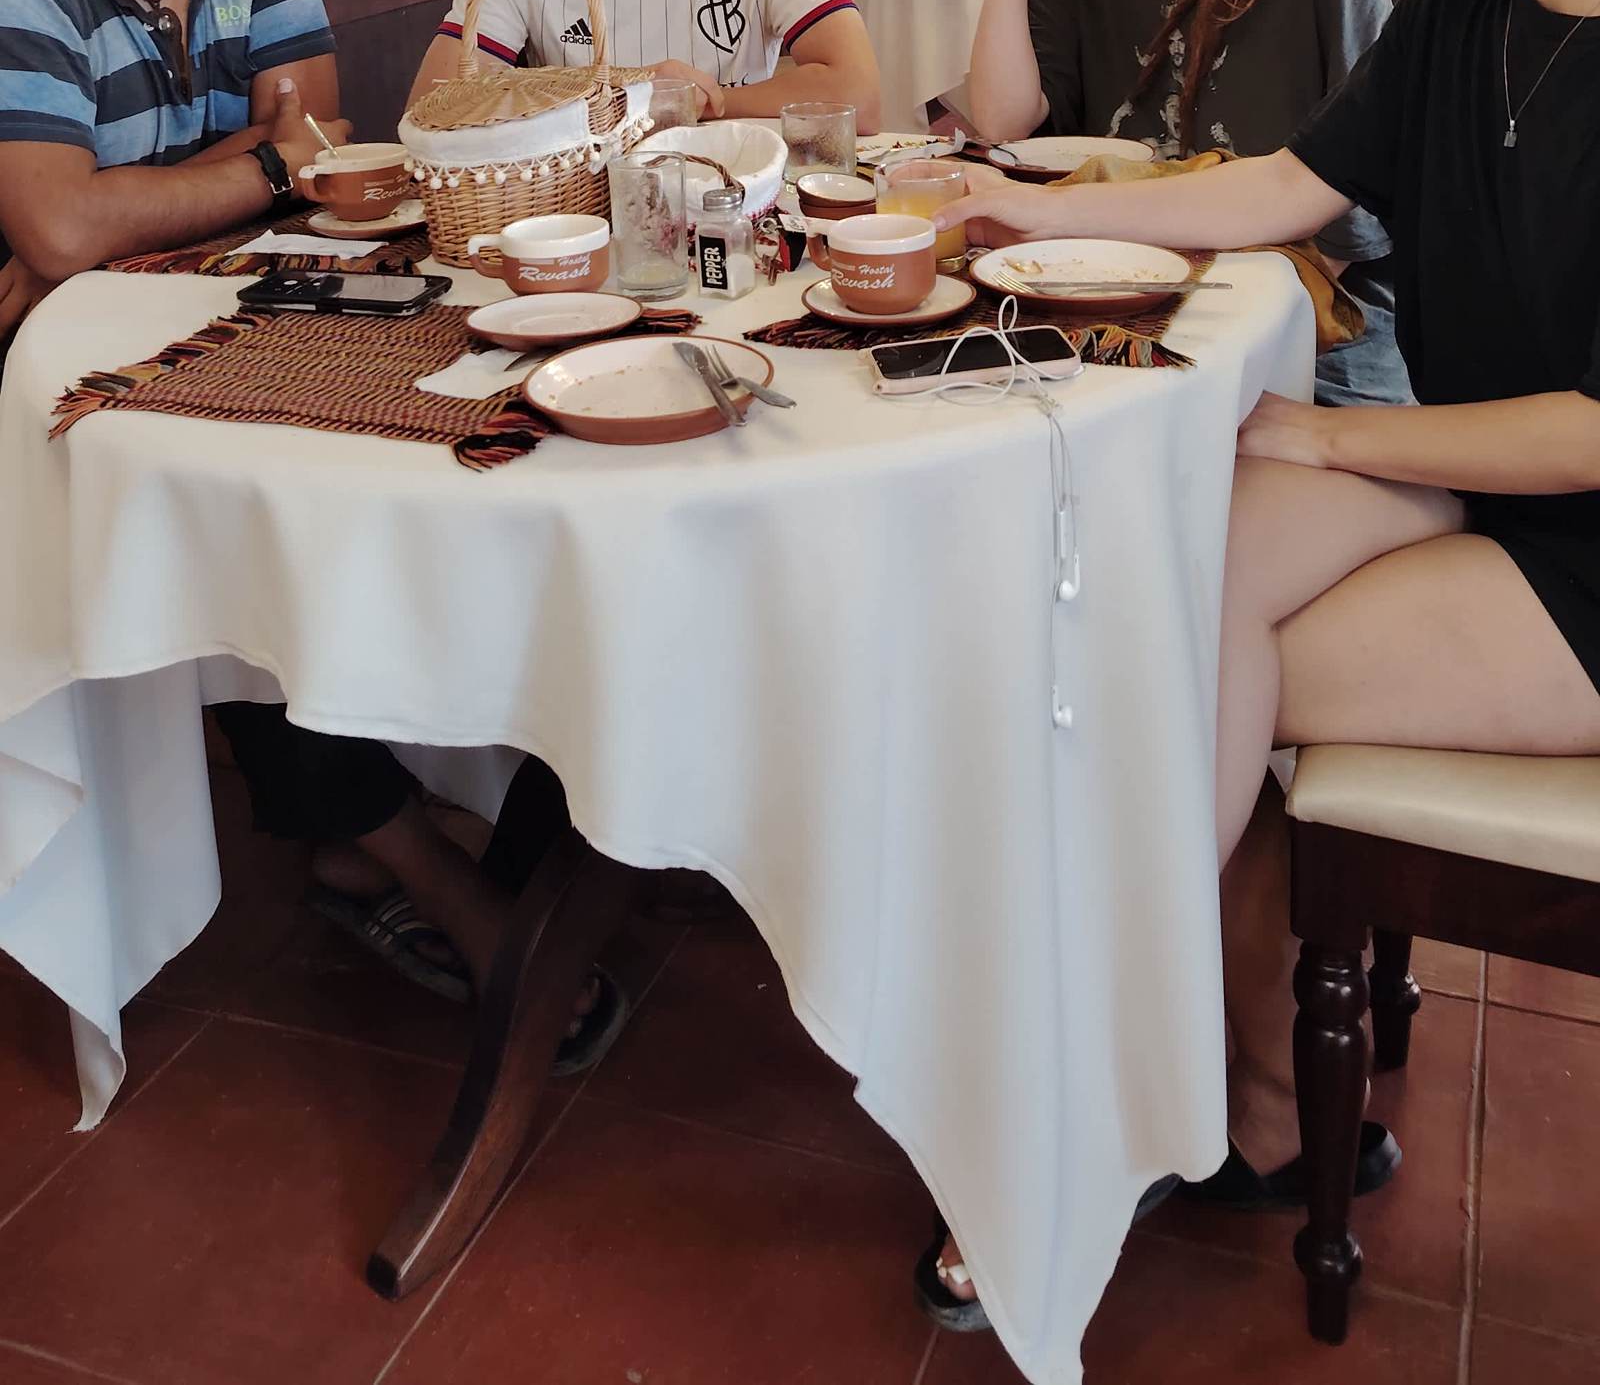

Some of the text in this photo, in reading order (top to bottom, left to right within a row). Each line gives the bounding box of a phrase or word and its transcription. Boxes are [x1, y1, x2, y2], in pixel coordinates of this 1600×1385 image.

[214, 5, 252, 23] BOS
[560, 33, 593, 45] adida
[518, 260, 592, 282] Revash
[704, 246, 723, 285] PEPPER
[858, 263, 895, 275] Hostal
[831, 271, 896, 289] Revash
